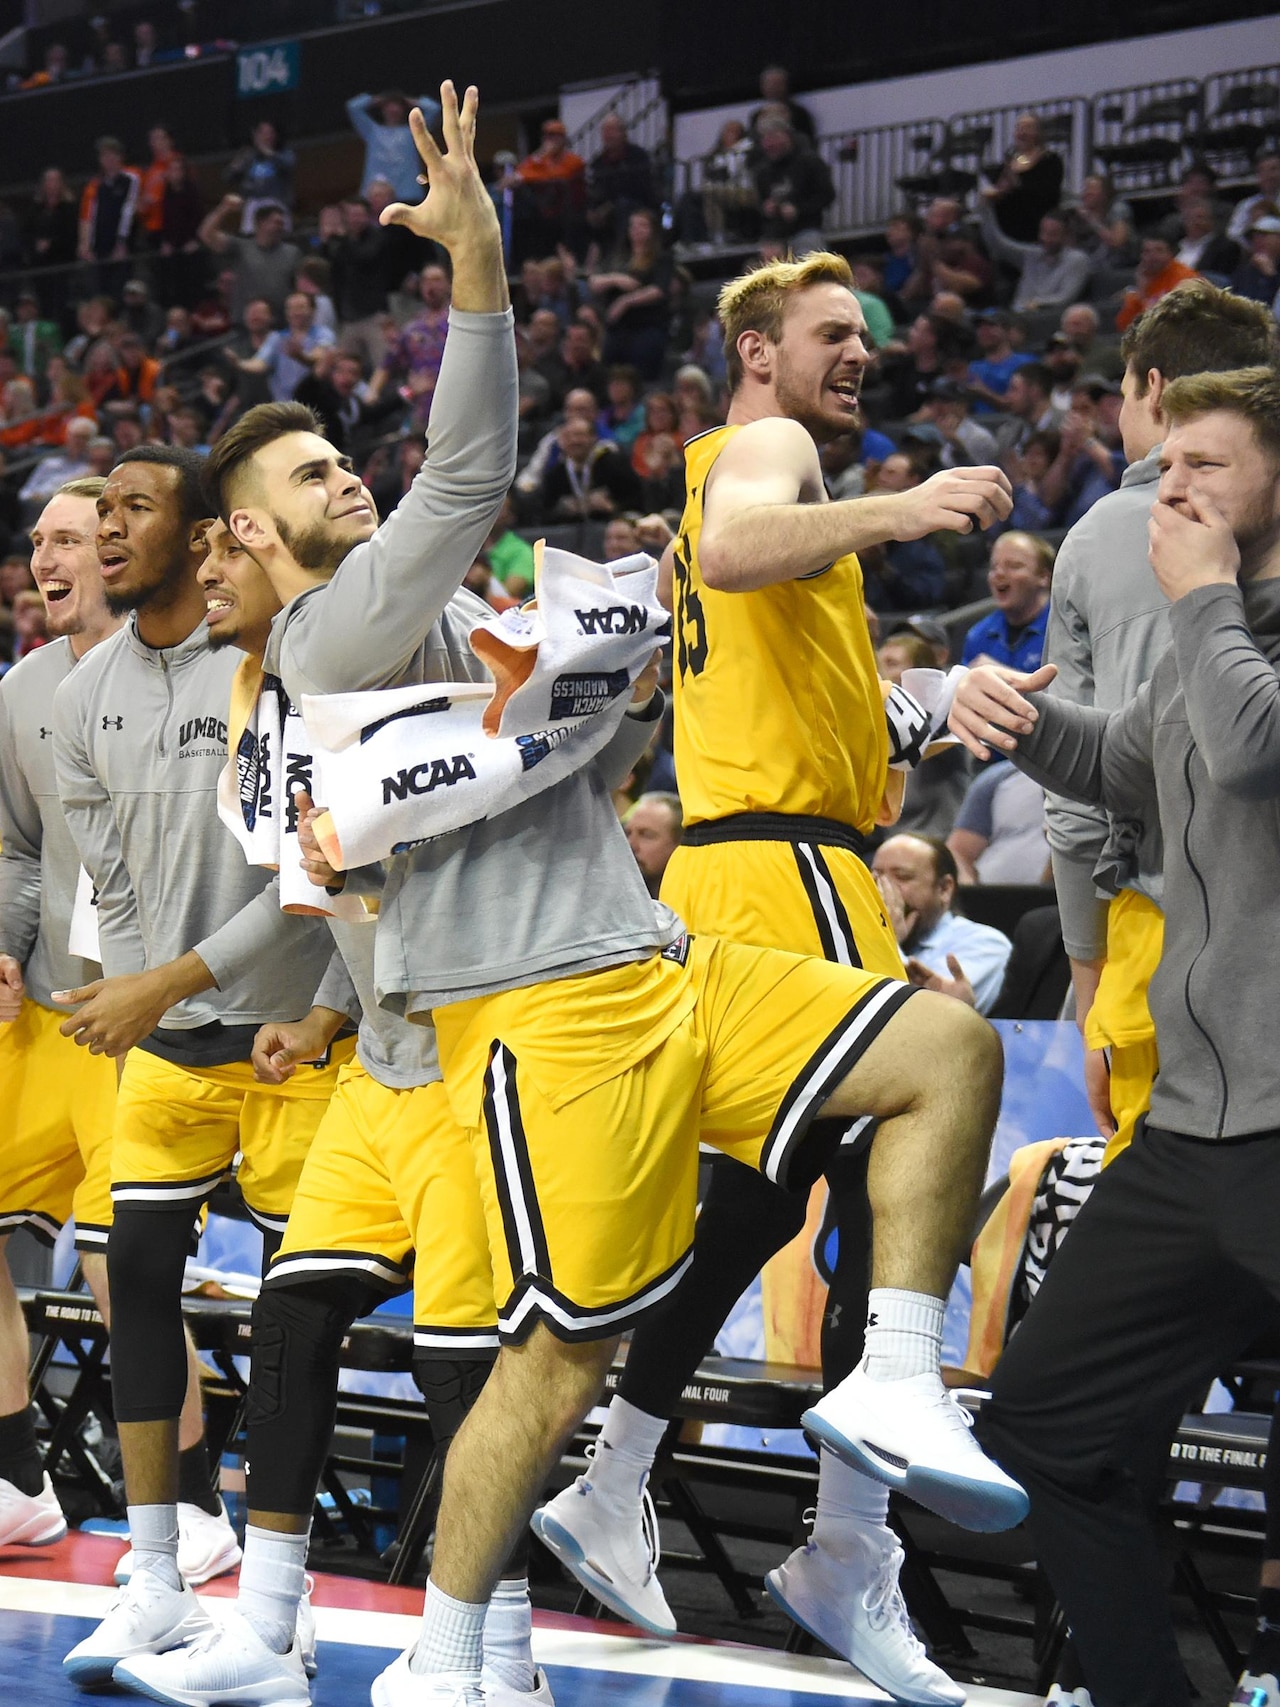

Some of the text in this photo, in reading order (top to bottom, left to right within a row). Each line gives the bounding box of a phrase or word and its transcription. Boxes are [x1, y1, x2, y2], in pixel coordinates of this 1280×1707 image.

[239, 48, 290, 92] 104
[575, 605, 648, 635] NCAA
[553, 679, 609, 697] MADNESS
[179, 716, 228, 747] UMBC
[179, 748, 229, 759] BASKETBALL
[381, 754, 477, 805] NCAA
[60, 1306, 81, 1320] ROAD
[81, 1308, 91, 1322] TO
[703, 1386, 730, 1403] FOUR
[1181, 1443, 1199, 1460] TO
[1199, 1445, 1223, 1464] THE
[1222, 1449, 1258, 1468] FINAL
